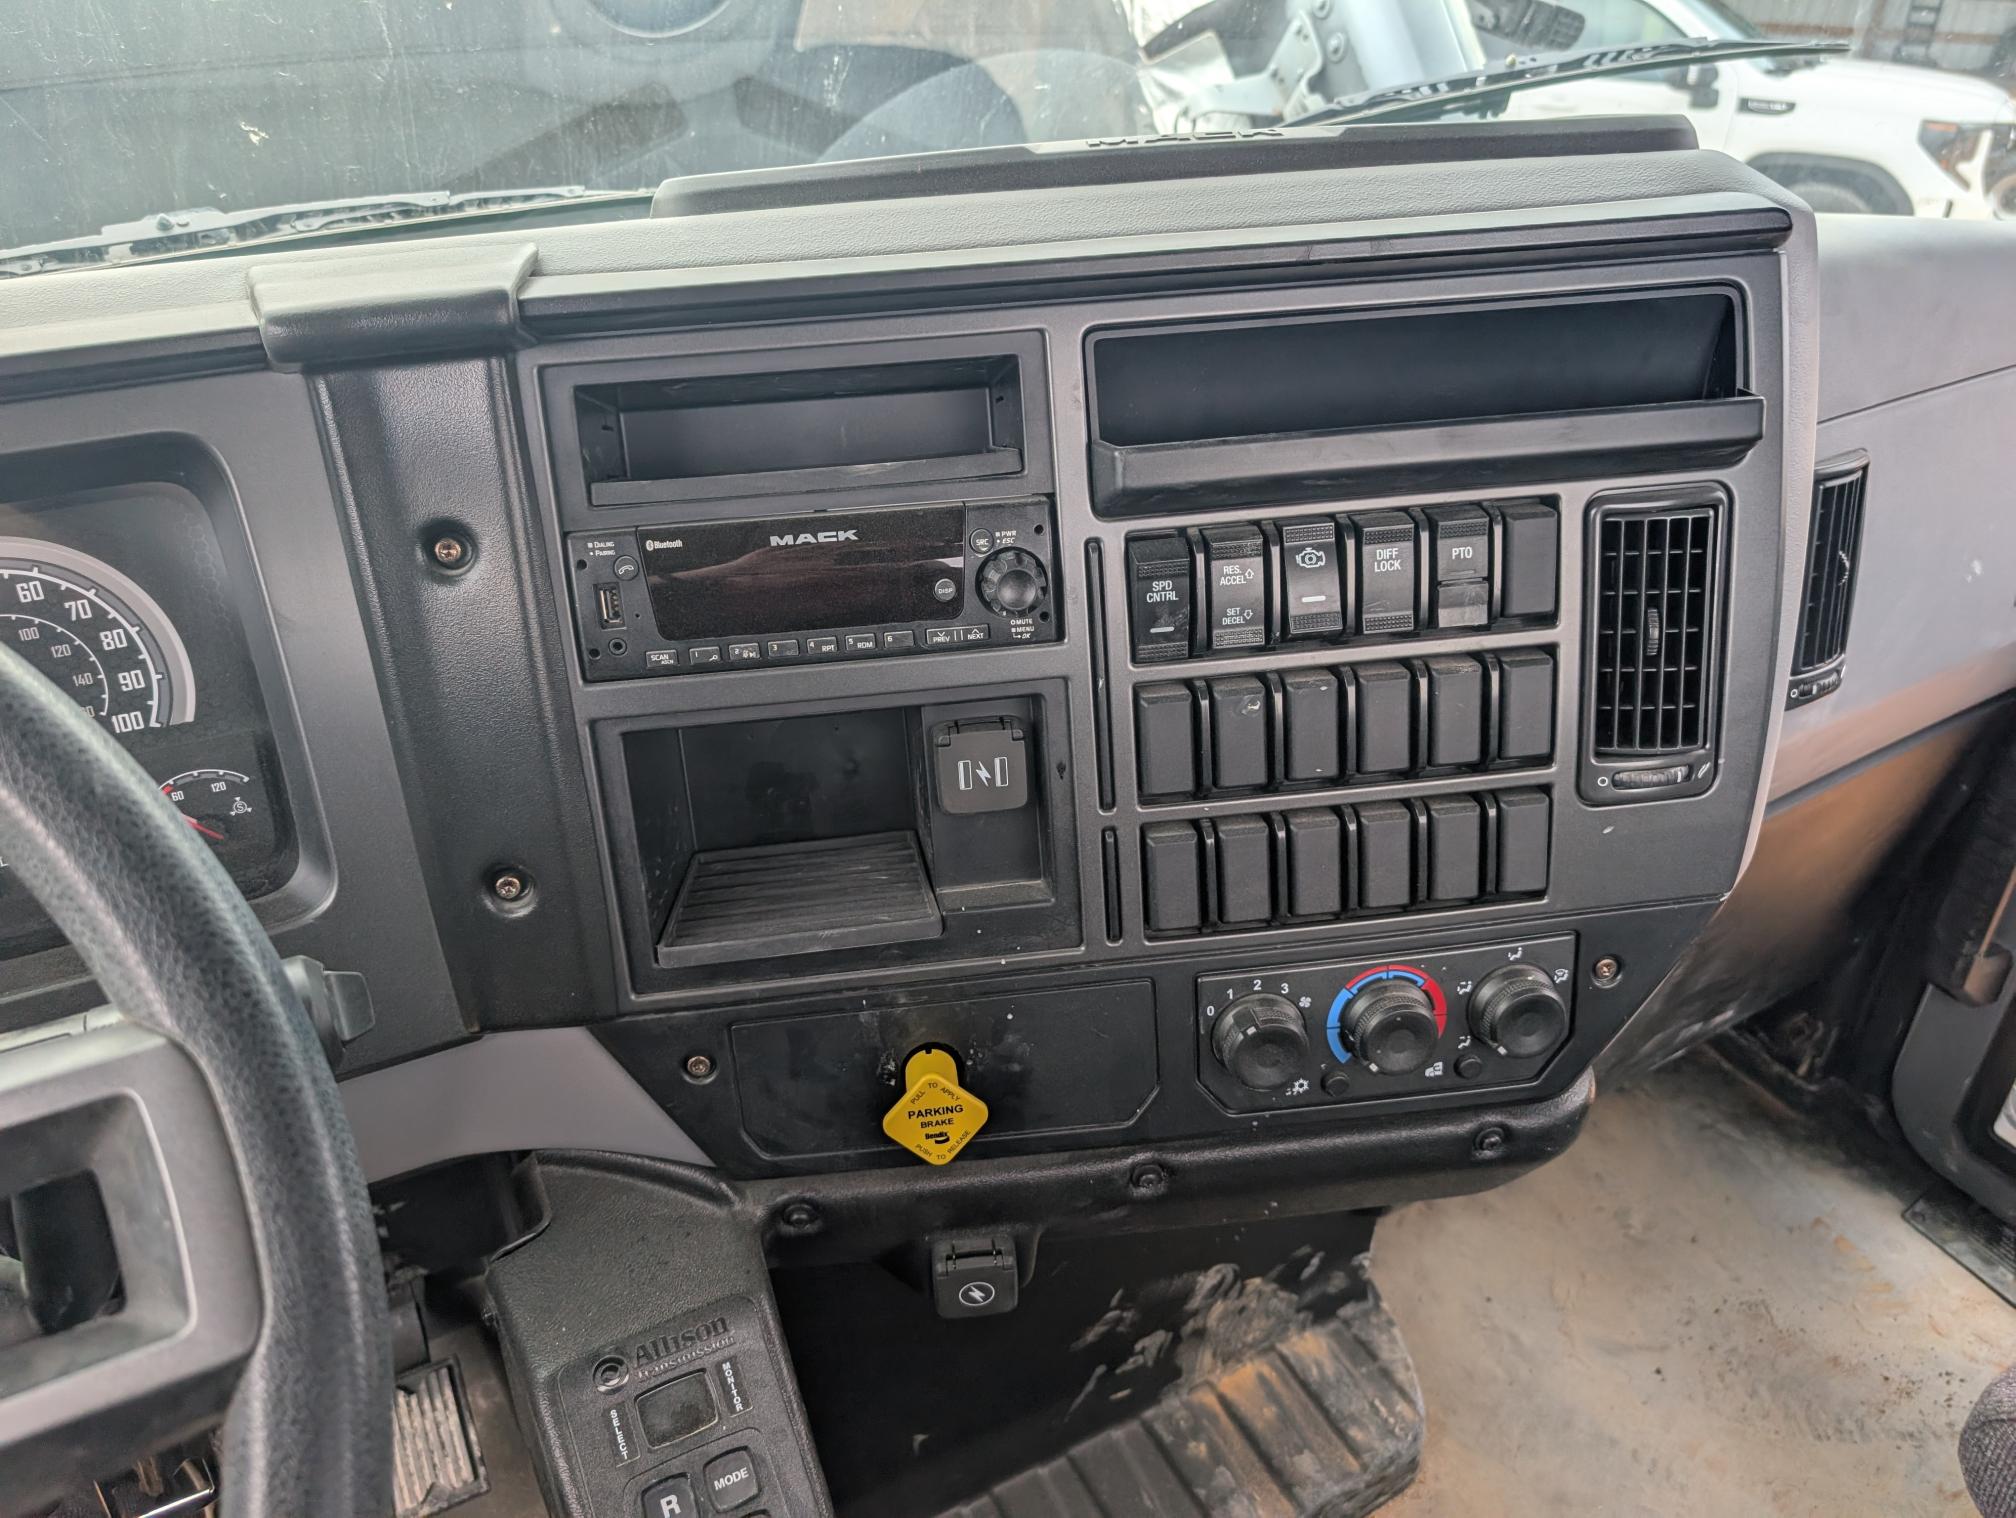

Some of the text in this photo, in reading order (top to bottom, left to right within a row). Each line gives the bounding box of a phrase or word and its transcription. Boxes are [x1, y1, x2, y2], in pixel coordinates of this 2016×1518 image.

[654, 539, 683, 550] Bluetooth
[770, 530, 859, 546] MACK
[976, 538, 989, 546] SRC
[1376, 548, 1399, 561] DIFF
[1452, 546, 1473, 560] PTO
[1223, 565, 1242, 575] RES.
[1374, 559, 1401, 573] LOCK
[1152, 580, 1173, 592] SPD
[1219, 574, 1247, 586] ACCEL
[16, 580, 45, 603] 60
[1146, 590, 1179, 604] CNTRL
[64, 599, 93, 622] 70
[1226, 607, 1240, 616] SET
[1222, 616, 1246, 626] DECEL
[18, 626, 40, 642] 100
[99, 628, 128, 651] 80
[50, 643, 72, 659] 120
[857, 641, 873, 649] RDM
[72, 672, 94, 687] 140
[118, 670, 146, 692] 90
[111, 711, 145, 734] 100
[211, 781, 227, 793] 120
[171, 791, 185, 802] 60
[1253, 979, 1262, 991] 2
[1281, 983, 1289, 994] 3
[1227, 988, 1234, 1000] 1
[1206, 1006, 1215, 1016] 0
[910, 1090, 926, 1105] PULL
[940, 1087, 960, 1102] APPLY
[908, 1104, 964, 1120] PARKING
[920, 1117, 954, 1129] BRAKE
[915, 1143, 933, 1157] PUSH
[947, 1130, 971, 1154] RELEASE
[635, 1317, 729, 1370] Allison
[722, 1361, 744, 1412] MONITOR
[610, 1409, 629, 1460] SELECT
[713, 1467, 749, 1491] MODE
[660, 1494, 681, 1518] R
